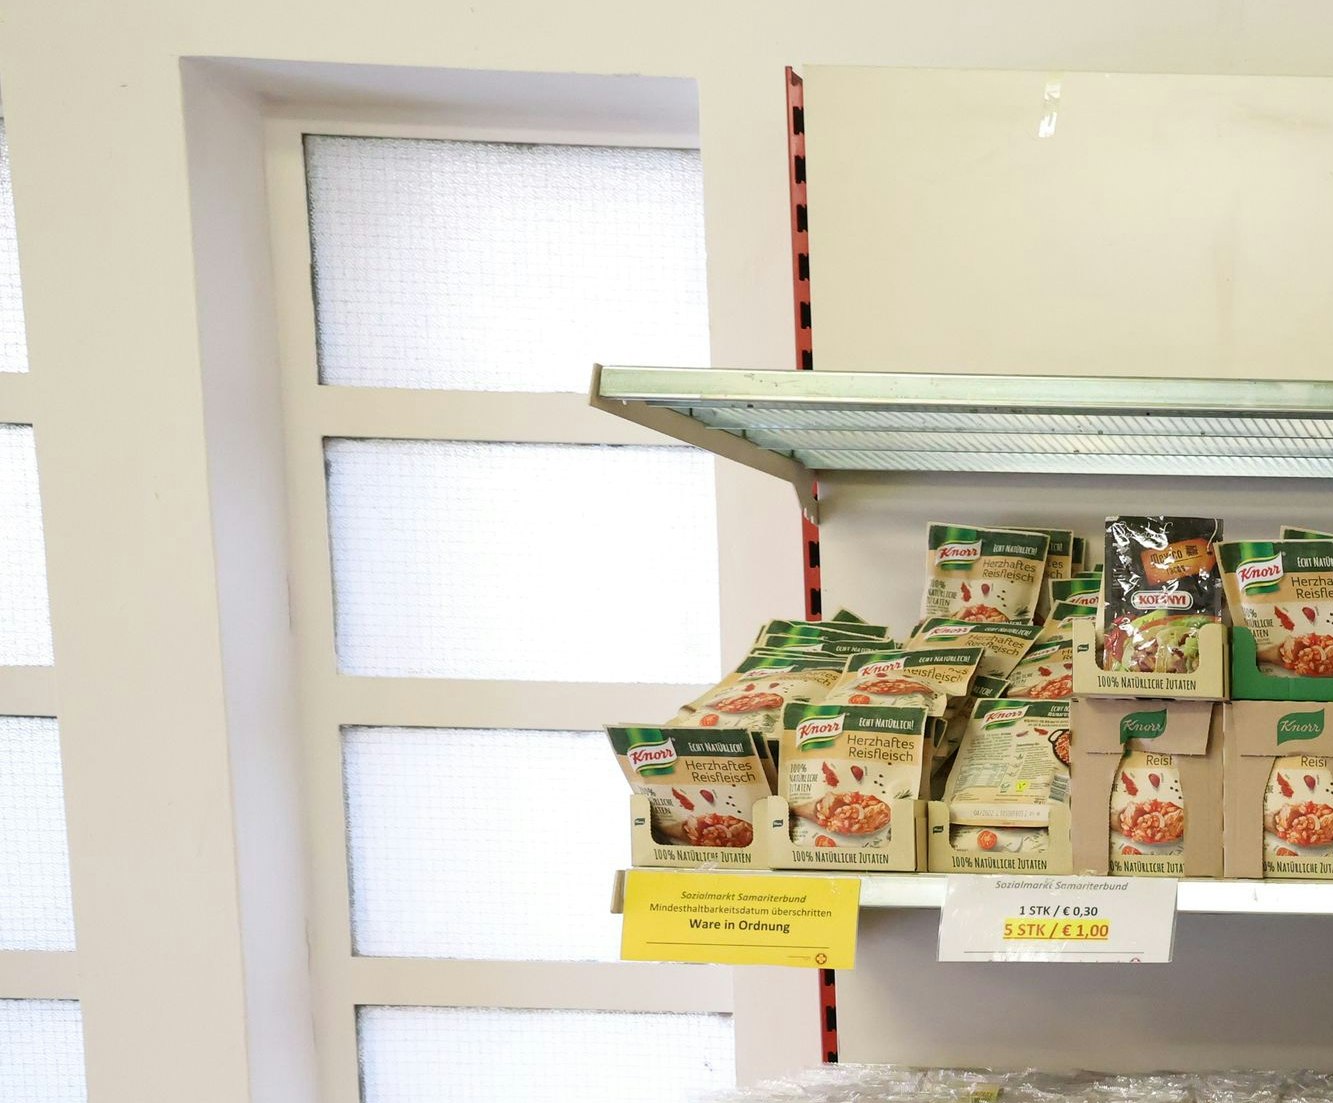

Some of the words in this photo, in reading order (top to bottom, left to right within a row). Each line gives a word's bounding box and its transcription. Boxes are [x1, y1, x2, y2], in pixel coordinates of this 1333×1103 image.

[940, 546, 977, 559] Knorr
[983, 560, 1036, 573] Herzhaftes
[1238, 565, 1281, 582] Knorr
[984, 569, 1035, 582] Reisfleisch
[862, 661, 902, 676] Knorr
[1098, 676, 1119, 689] 100%
[1121, 676, 1164, 690] NATÜRLICHE
[1166, 678, 1196, 691] ZUTATEN
[798, 721, 843, 739] Knorr
[876, 717, 914, 731] NATÜRLICH!
[1124, 720, 1162, 733] Knorr
[1281, 720, 1321, 733] Knorr
[704, 741, 744, 754] NATÜRLICH!
[847, 734, 914, 750] Herzhaftes
[630, 748, 675, 763] Knorr
[849, 748, 913, 762] Reisfleisch
[686, 760, 752, 772] Herzhaftes
[692, 771, 756, 784] Reisfleisch
[653, 849, 676, 861] 100%
[677, 850, 718, 864] NATÜRLICHE
[721, 852, 752, 864] ZUTATEN
[792, 850, 814, 863] 100%
[815, 851, 857, 865] NATÜRLICHE
[858, 852, 889, 865] ZUTATEN
[952, 856, 973, 868] 100%
[974, 857, 1016, 870] NATÜRLICHE
[1017, 858, 1047, 870] ZUTATEN
[1124, 861, 1165, 874] NATÜRLICHE
[1277, 861, 1318, 874] NATÜRLICHE
[1055, 881, 1128, 891] Samariterbund
[681, 891, 735, 902] Sozialmarkt
[737, 892, 807, 904] Samariterbund
[650, 904, 770, 916] Mindesthaltbarkeitsdatum
[772, 906, 832, 918] überschritten
[1020, 906, 1025, 916] 1
[1030, 906, 1050, 916] STK
[1053, 905, 1060, 917] /
[1063, 906, 1070, 916] €
[1073, 906, 1098, 918] 0,30
[690, 919, 721, 931] Ware
[724, 919, 736, 932] in
[738, 920, 790, 934] Ordnung
[1004, 922, 1012, 936] 5
[1016, 923, 1045, 937] STK
[1050, 922, 1057, 938] /
[1062, 924, 1073, 937] €
[1077, 924, 1108, 938] 1,00
